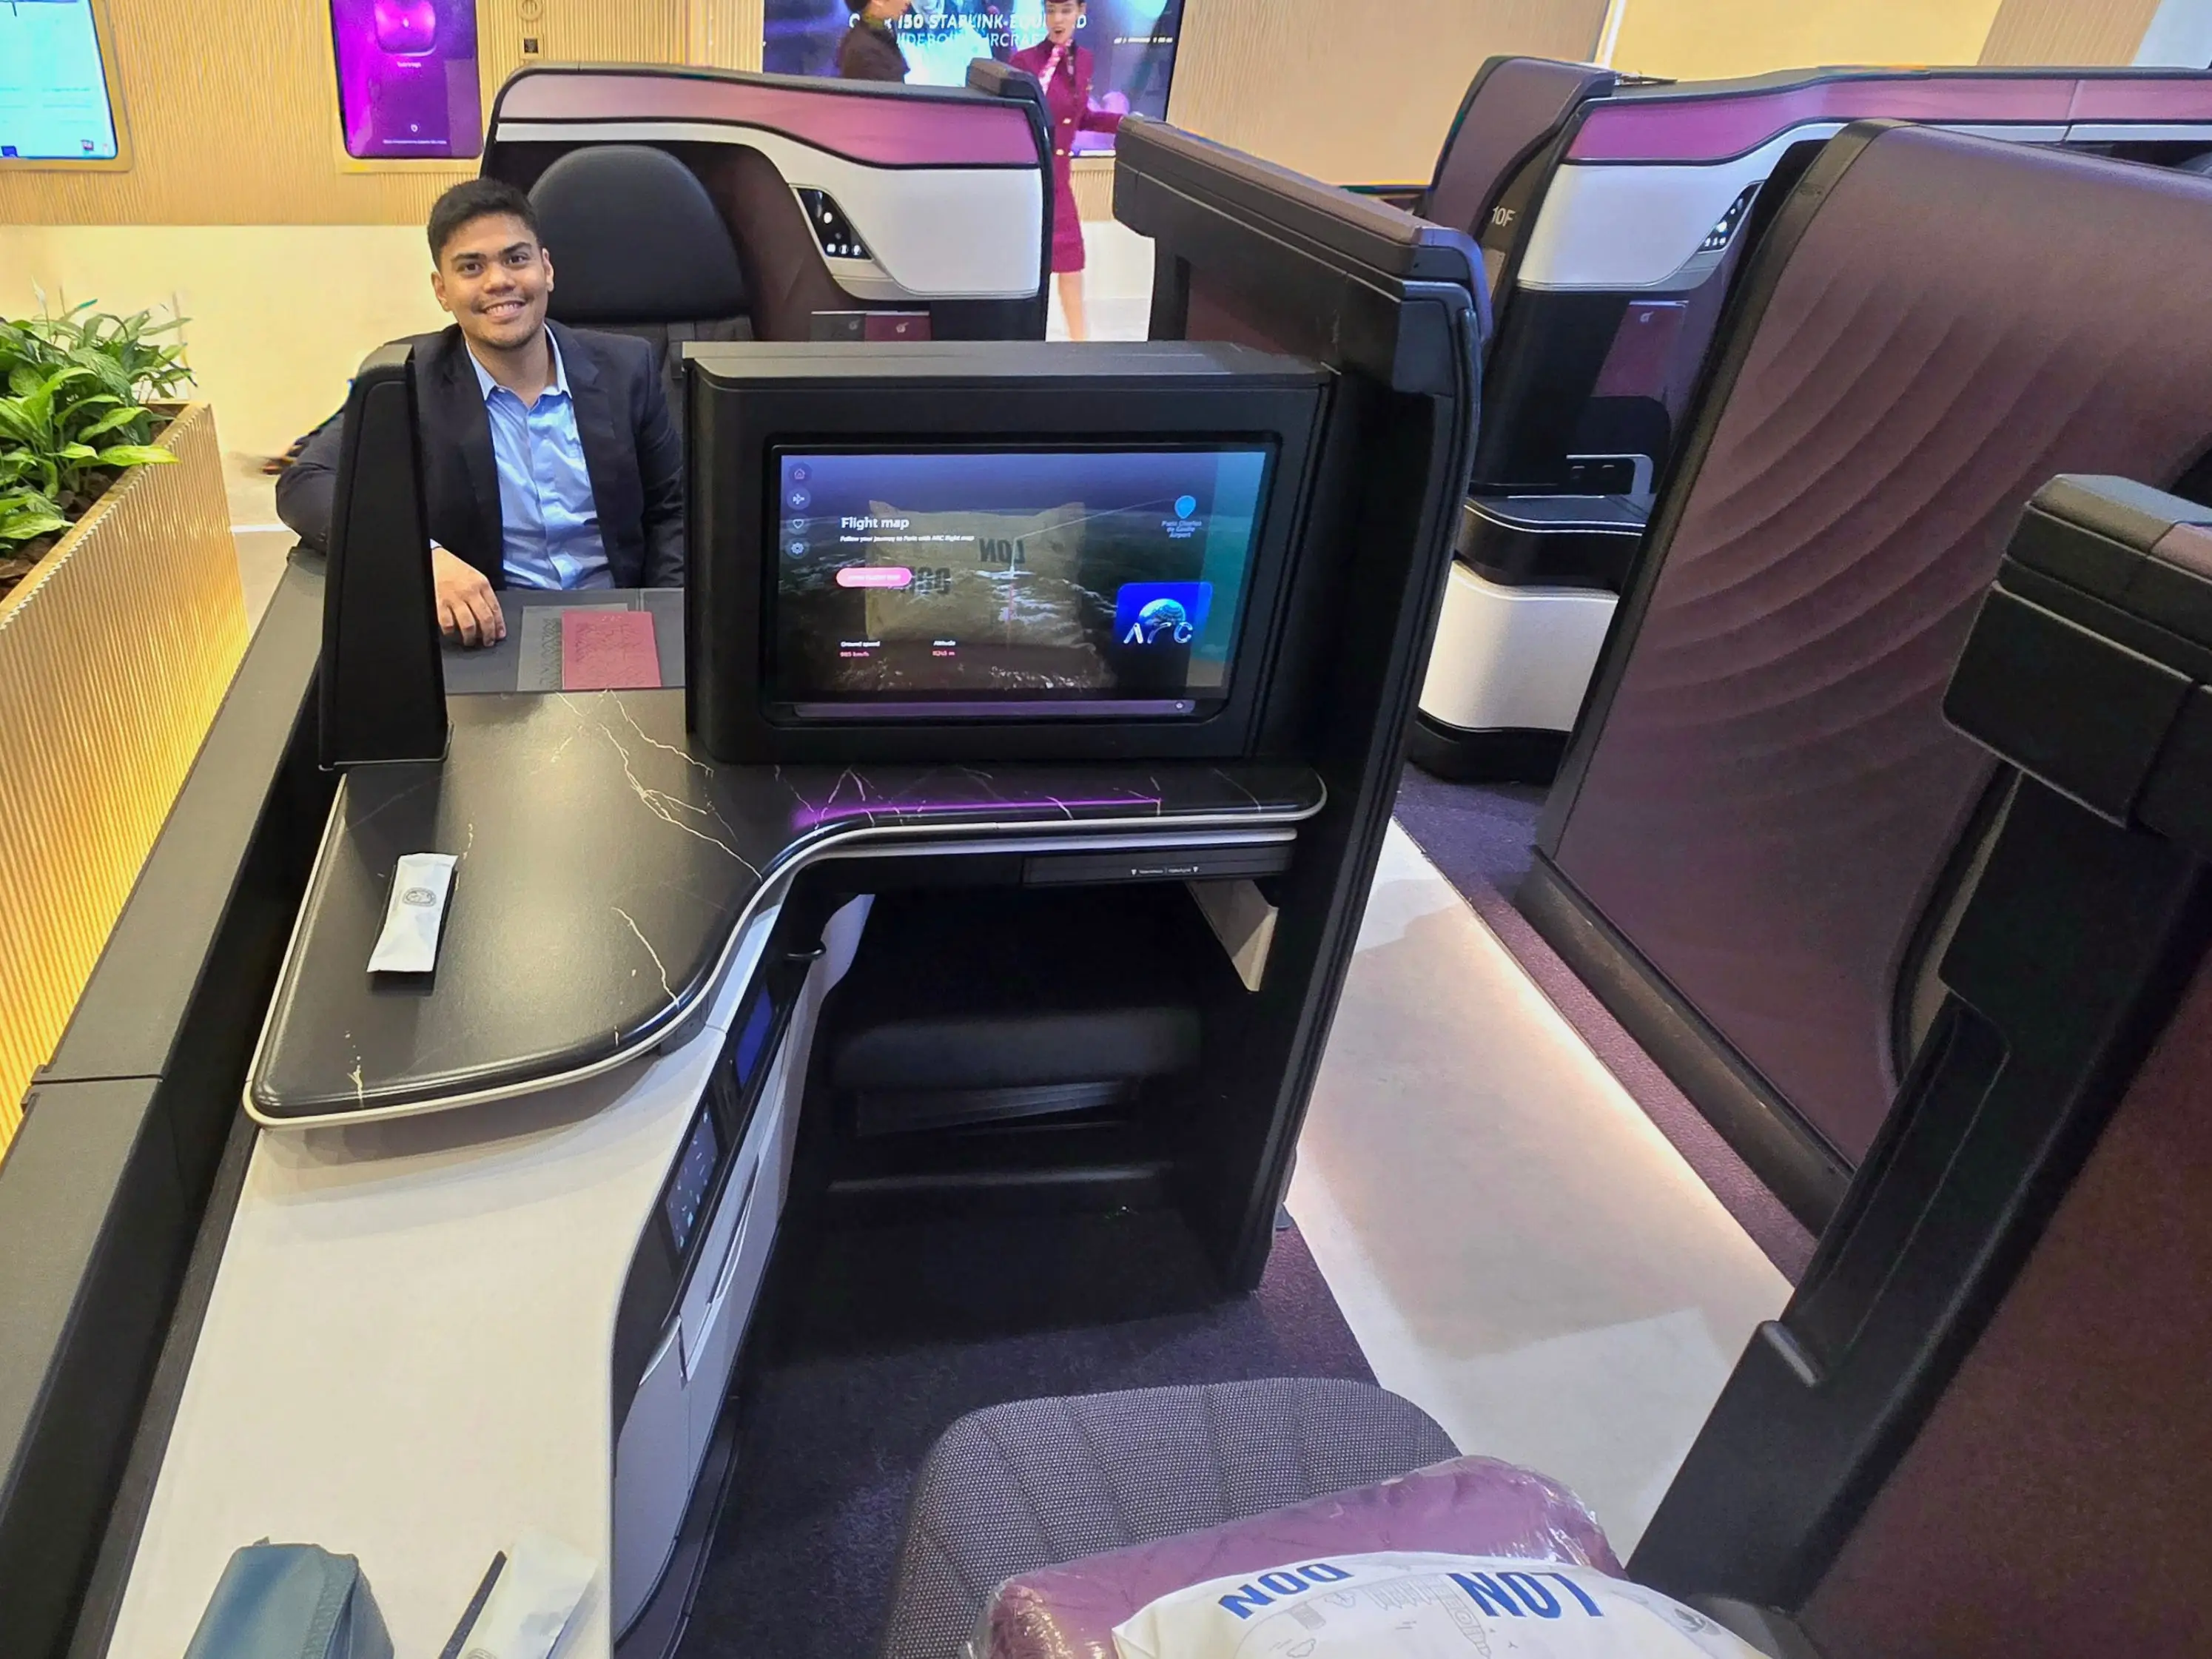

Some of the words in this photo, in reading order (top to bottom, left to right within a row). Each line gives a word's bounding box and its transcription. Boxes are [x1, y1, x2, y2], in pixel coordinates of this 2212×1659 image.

[898, 13, 924, 29] 150
[1491, 206, 1516, 227] 10F
[841, 516, 878, 531] Flight
[881, 519, 910, 531] map
[1218, 1564, 1354, 1620] DON
[1446, 1572, 1604, 1618] LON
